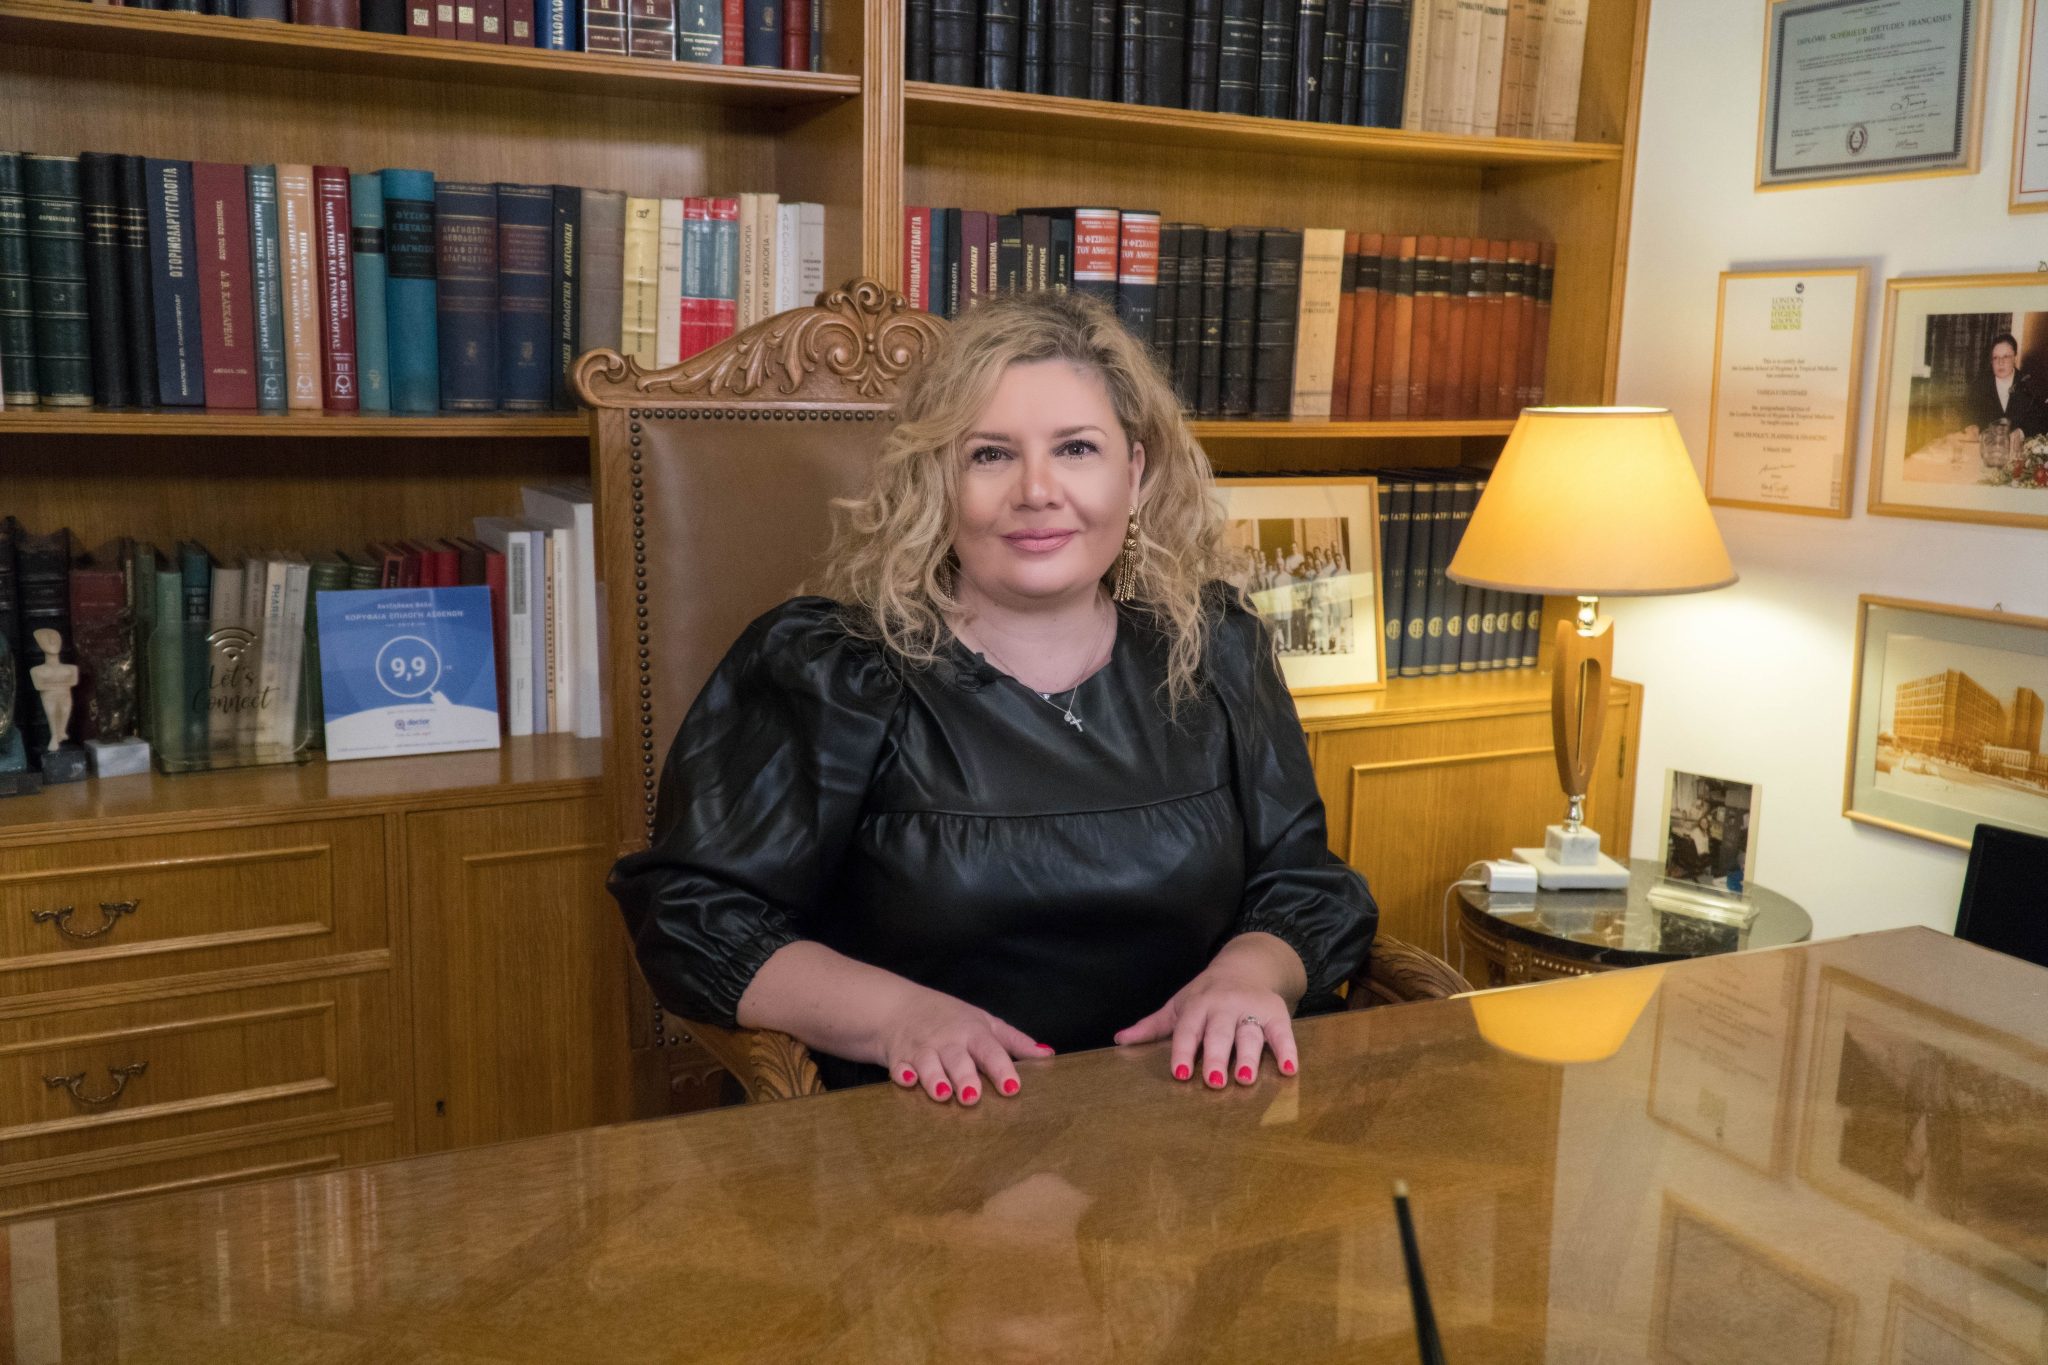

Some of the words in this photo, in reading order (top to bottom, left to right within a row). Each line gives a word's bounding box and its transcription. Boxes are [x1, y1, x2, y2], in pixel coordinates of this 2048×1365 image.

[564, 223, 573, 278] ΑΝΑΤΟΜΙΚΗ
[969, 245, 979, 295] ΑΝΑΤΟΜΙΚΗ
[208, 664, 256, 689] Let's
[391, 656, 427, 682] 9,9
[191, 685, 281, 715] Connect
